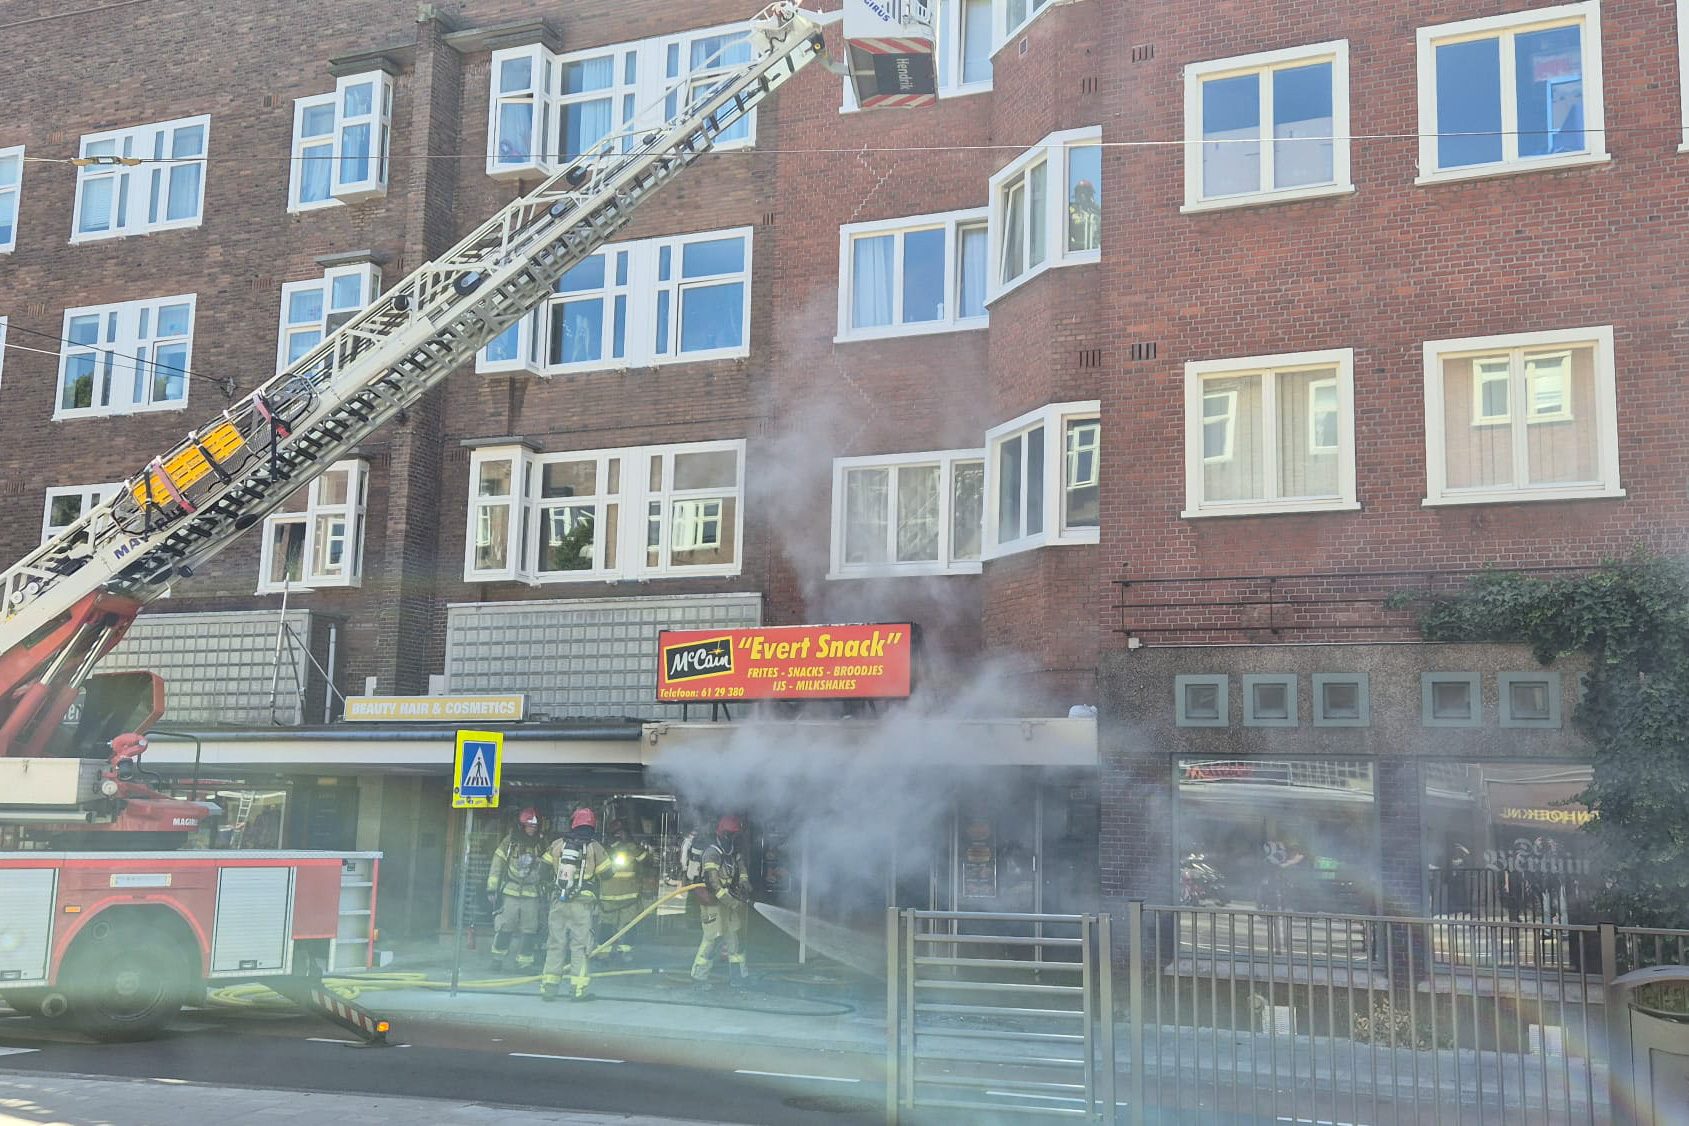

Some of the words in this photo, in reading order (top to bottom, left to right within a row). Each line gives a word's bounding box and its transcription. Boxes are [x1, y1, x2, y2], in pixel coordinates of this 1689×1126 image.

[896, 58, 914, 90] Hendrik
[670, 648, 732, 675] McCain
[747, 667, 779, 678] FRITES
[788, 666, 824, 677] SNACKS
[833, 665, 884, 676] BROODJES
[773, 681, 787, 691] IJS
[796, 680, 856, 691] MILKSHAKES
[660, 688, 698, 698] Telefoon:
[701, 687, 712, 697] 61
[714, 687, 726, 697] 29
[727, 686, 744, 697] 380
[352, 703, 397, 714] BEAUTY
[400, 703, 429, 714] HAIR
[432, 702, 441, 714] &
[446, 702, 515, 714] COSMETICS
